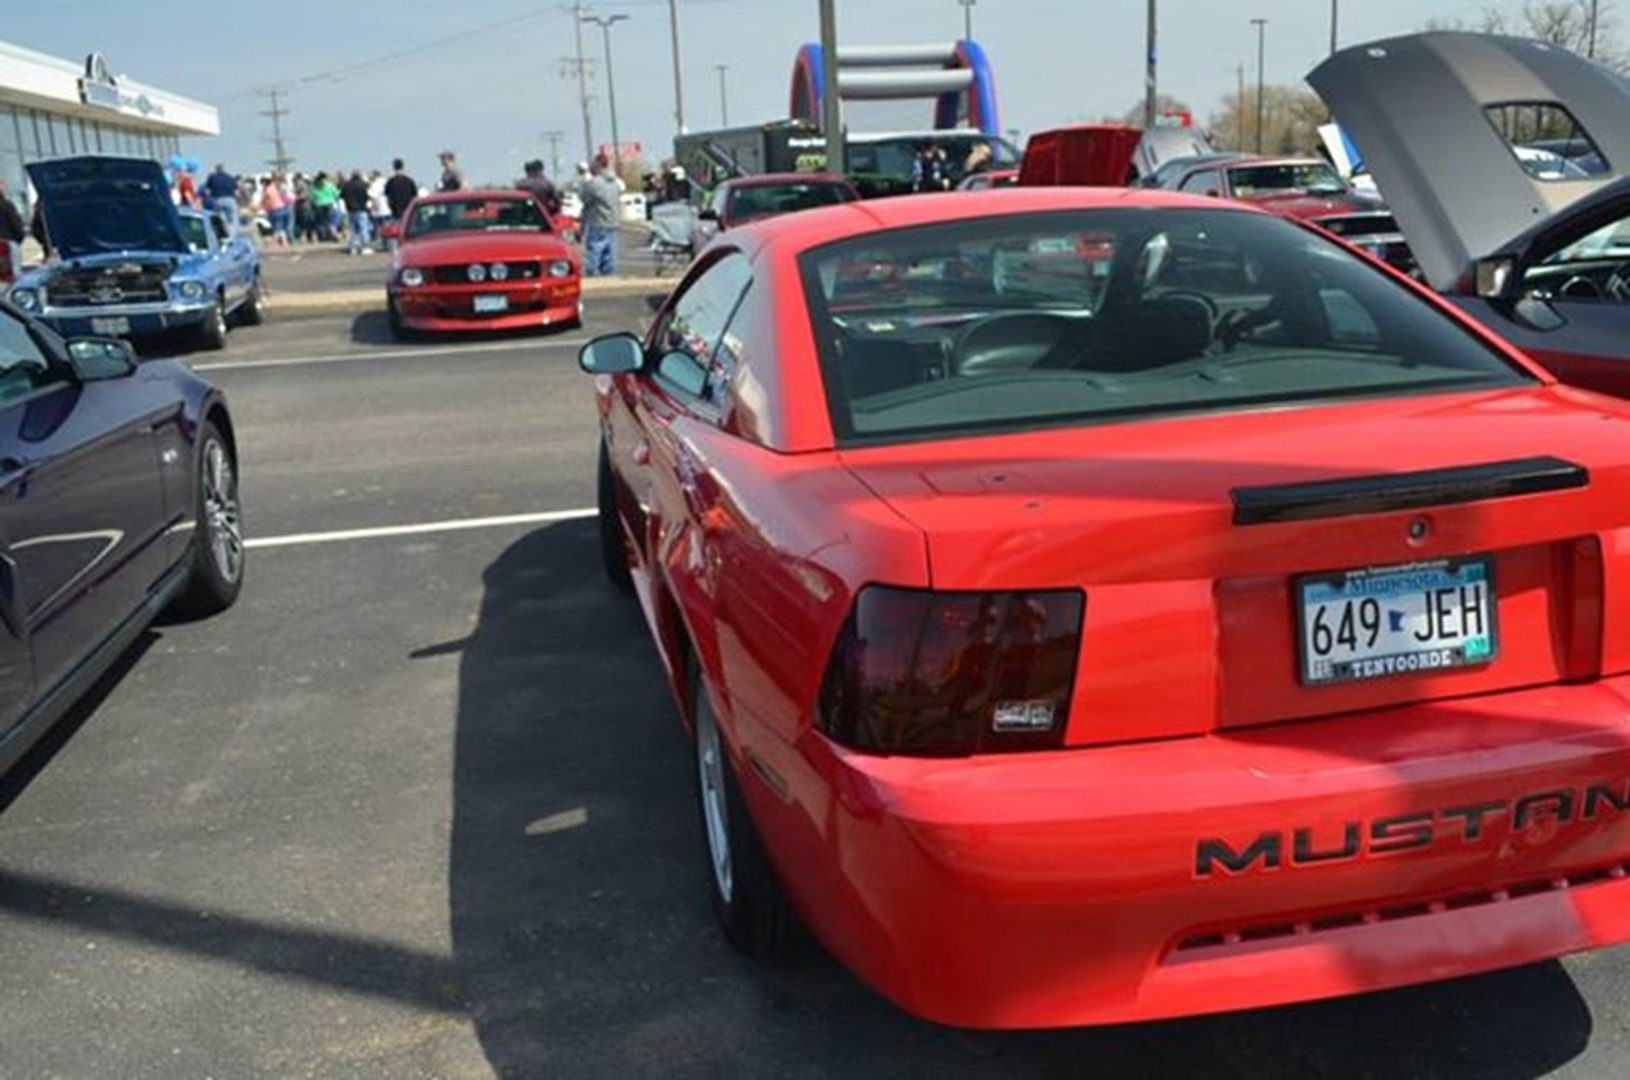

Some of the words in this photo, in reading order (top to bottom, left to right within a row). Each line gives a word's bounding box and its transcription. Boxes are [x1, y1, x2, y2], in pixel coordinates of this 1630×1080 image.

[1312, 597, 1381, 656] 649
[1414, 586, 1483, 642] JEH
[1351, 650, 1451, 678] TENVOORDE
